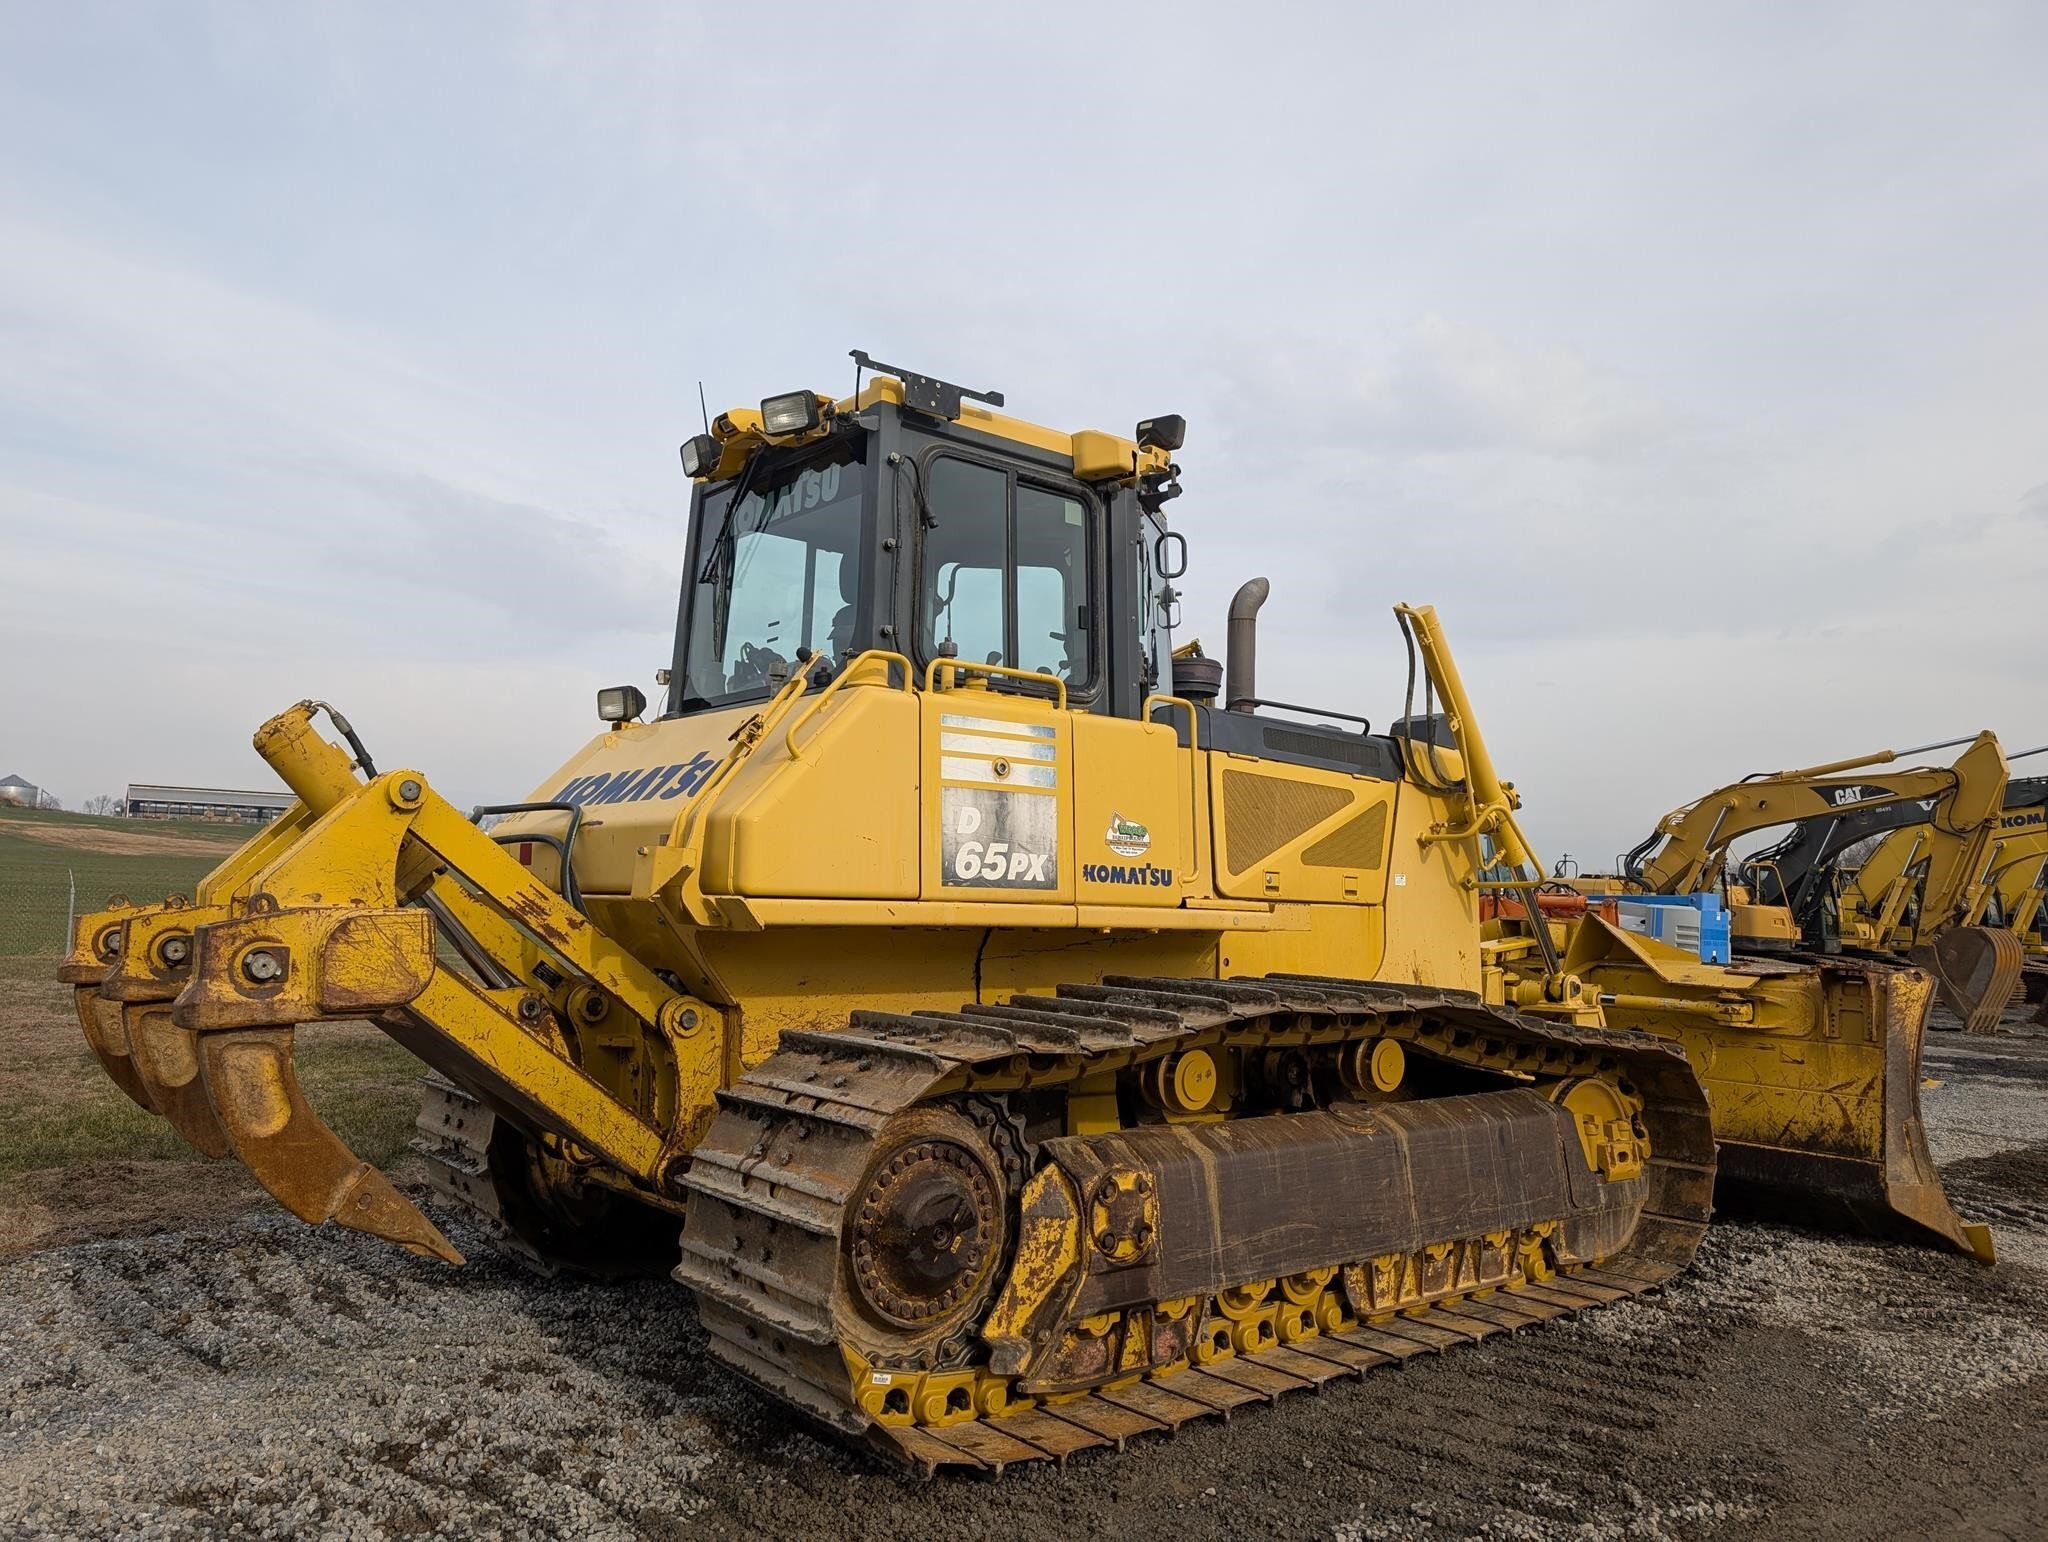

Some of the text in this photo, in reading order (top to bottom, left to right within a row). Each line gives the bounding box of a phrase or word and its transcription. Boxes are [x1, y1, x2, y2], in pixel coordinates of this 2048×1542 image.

[1834, 785, 1862, 805] CAT
[956, 806, 981, 834] D
[1083, 862, 1172, 887] KOMATSU
